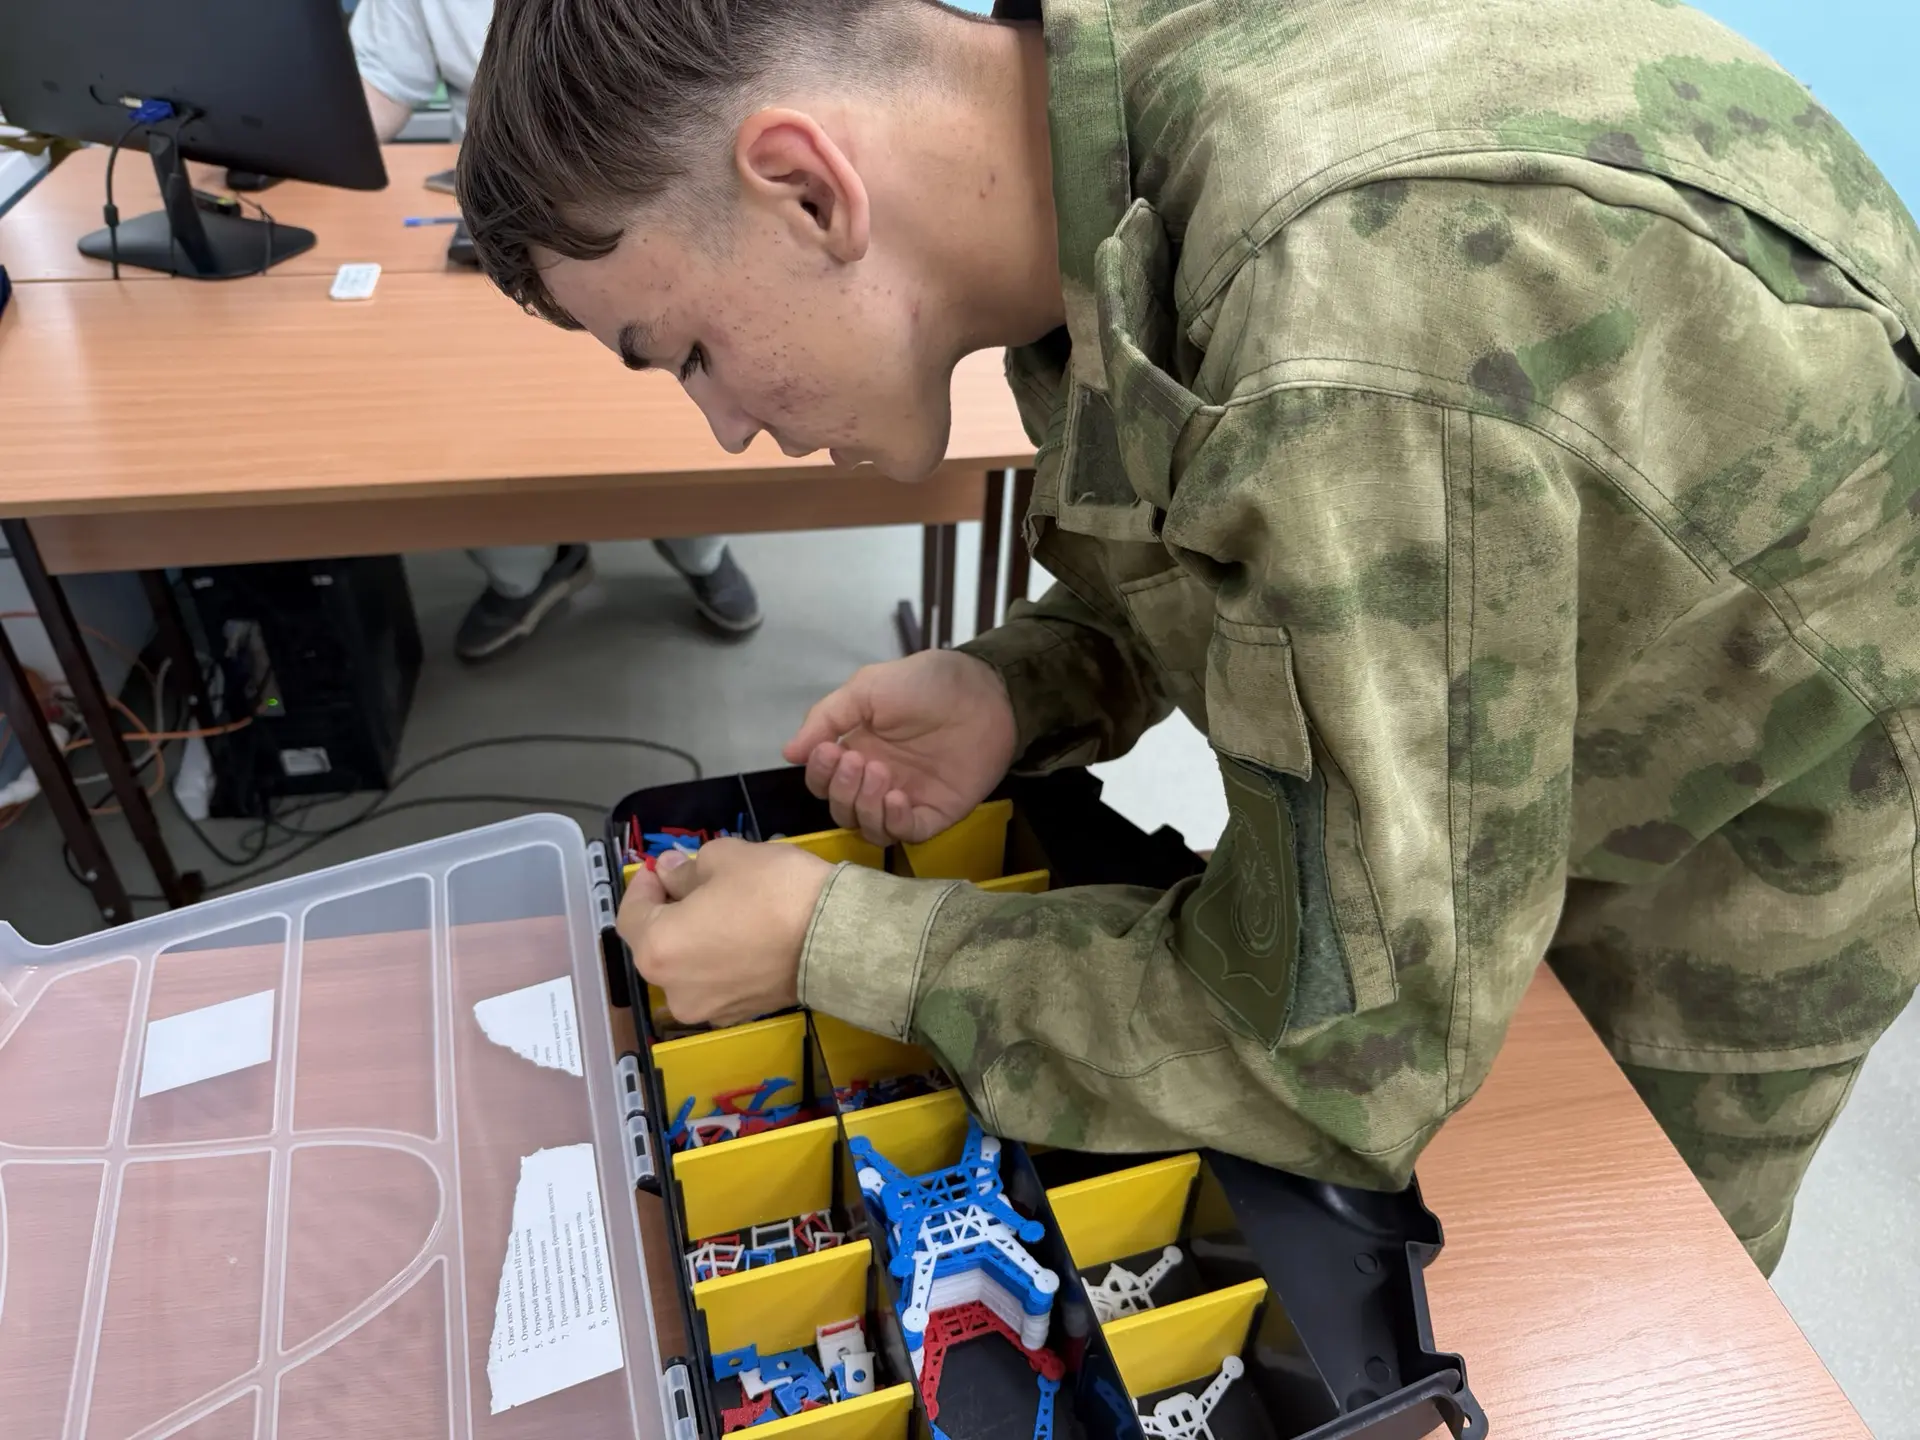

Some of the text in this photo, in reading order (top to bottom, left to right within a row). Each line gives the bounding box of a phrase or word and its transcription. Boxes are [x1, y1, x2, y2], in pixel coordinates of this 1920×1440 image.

[596, 1275, 608, 1313] Открытый
[531, 1297, 543, 1336] Открытый
[600, 1316, 610, 1326] 9.
[534, 1340, 544, 1349] 5.
